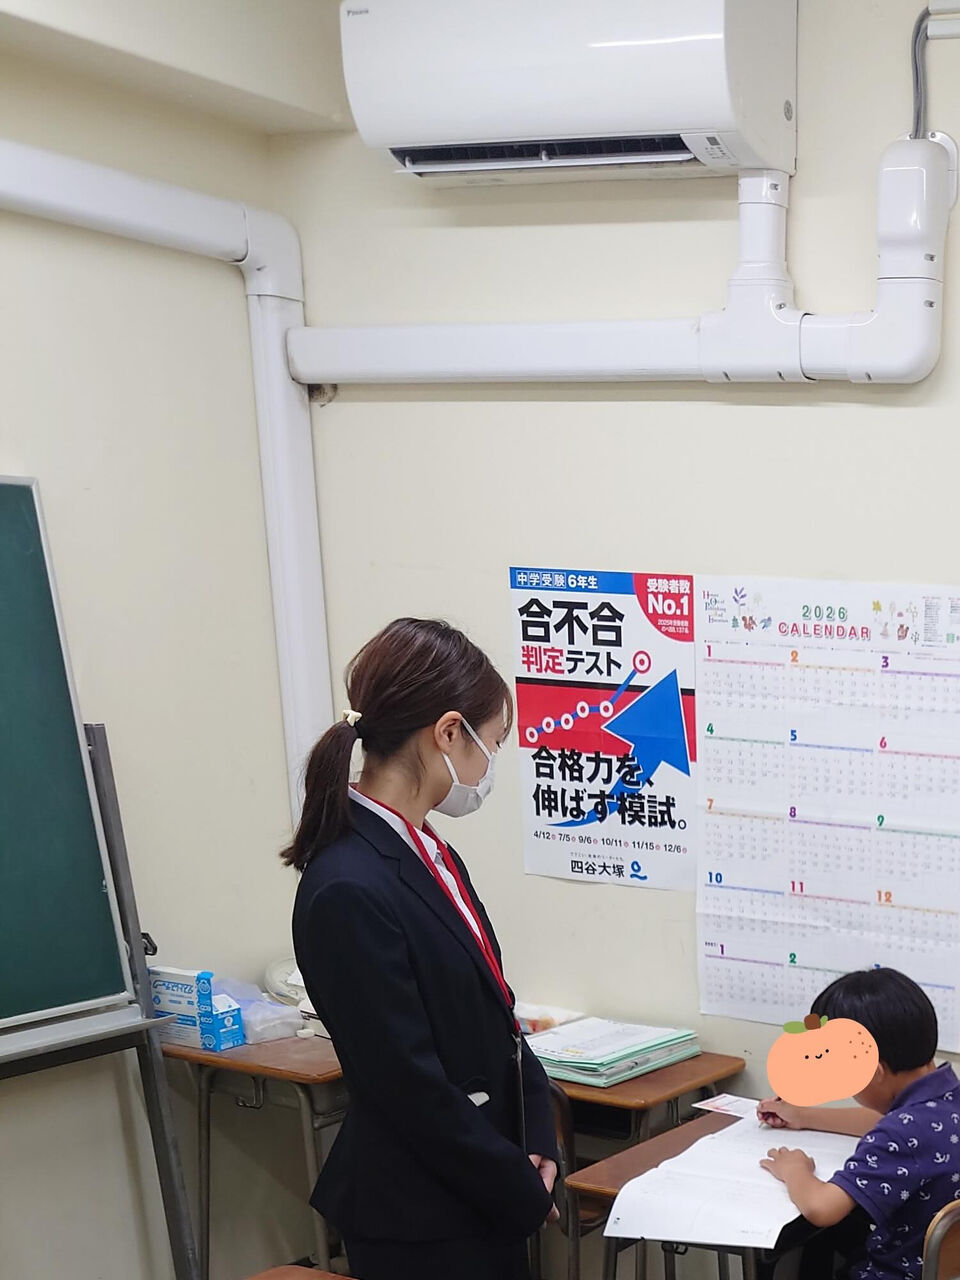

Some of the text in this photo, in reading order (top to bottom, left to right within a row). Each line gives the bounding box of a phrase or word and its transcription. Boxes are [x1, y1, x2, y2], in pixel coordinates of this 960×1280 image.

[647, 578, 690, 594] 受験者数
[648, 594, 689, 615] No.1
[802, 604, 848, 620] 2026
[518, 598, 625, 647] 合不合
[778, 621, 871, 641] CALENDAR
[521, 645, 622, 677] 判定テスト
[707, 645, 712, 657] 1
[790, 650, 798, 662] 2
[881, 656, 889, 668] 3
[706, 723, 887, 749] 4 5 6
[707, 798, 885, 827] 7 8 9
[571, 859, 625, 878] 四谷大塚
[708, 871, 892, 903] 10 11 12
[720, 944, 724, 955] 1
[789, 953, 797, 964] 2
